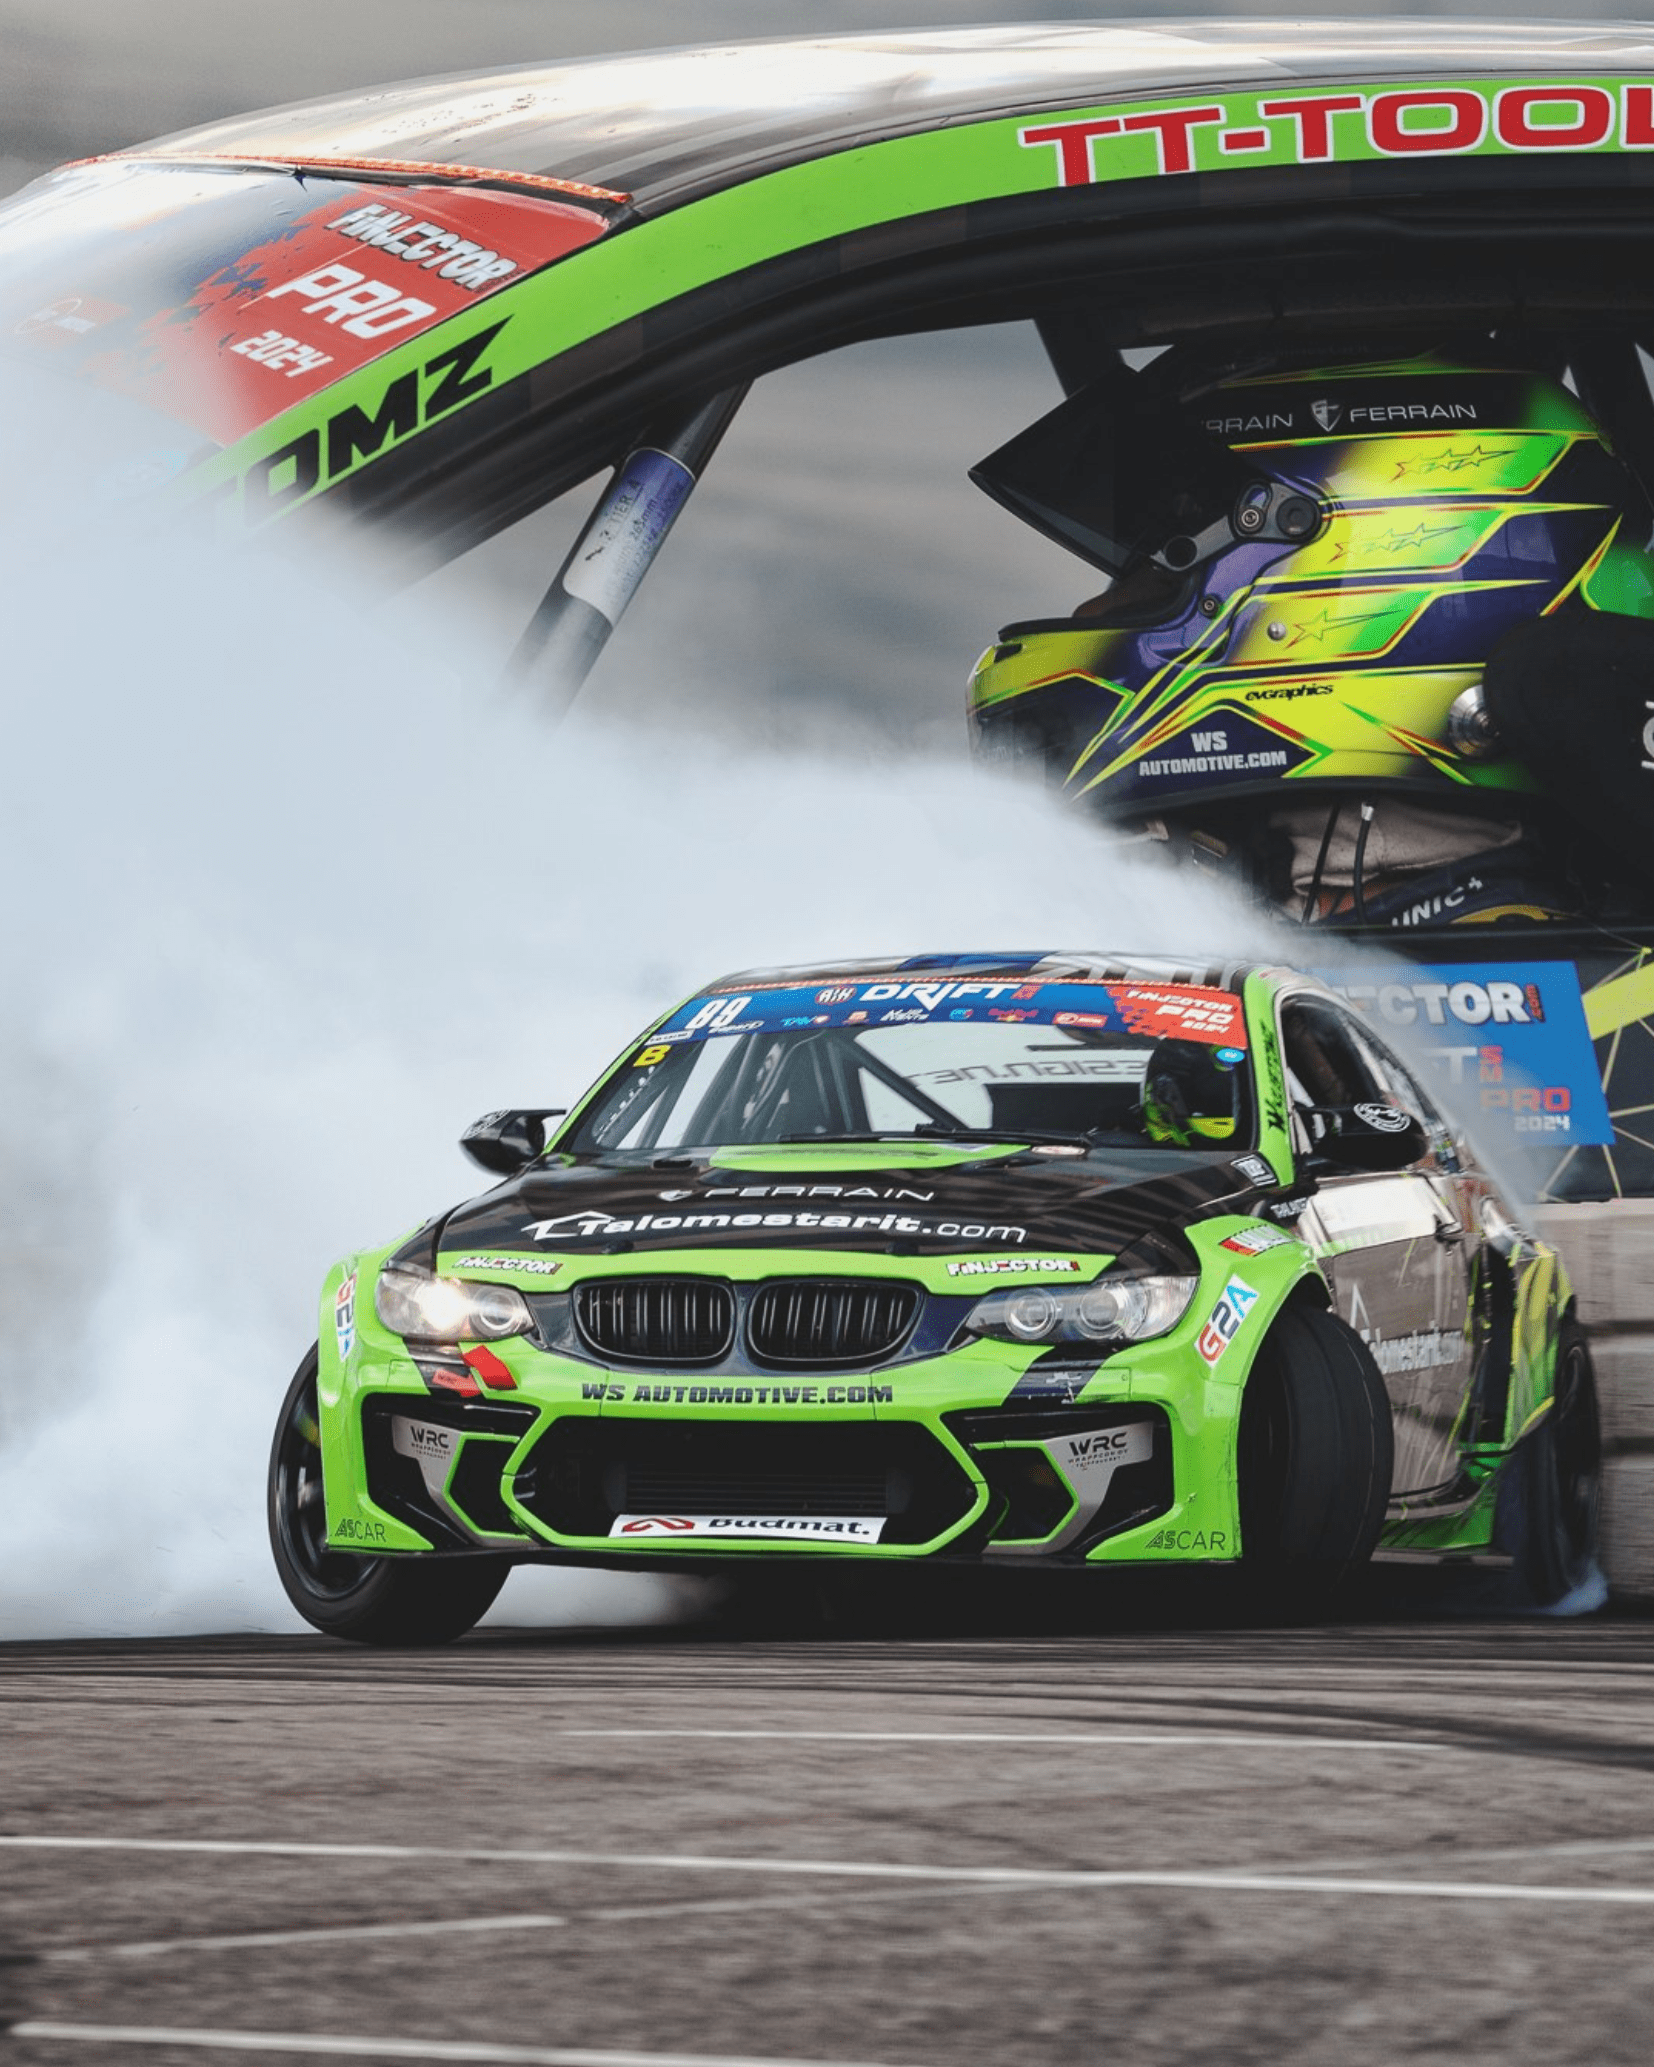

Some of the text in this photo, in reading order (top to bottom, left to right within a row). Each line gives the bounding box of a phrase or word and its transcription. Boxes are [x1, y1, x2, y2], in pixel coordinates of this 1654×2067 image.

[266, 264, 437, 339] PRO
[230, 329, 334, 377] 2024
[1206, 404, 1477, 433] RRAIN FERRAIN
[1191, 731, 1227, 752] WS
[1139, 750, 1287, 776] AUTOMOTIVE.COM
[859, 983, 1022, 1011] DRIFT
[1480, 1087, 1571, 1113] PRO
[1514, 1115, 1571, 1132] 2024
[705, 1187, 934, 1201] FERRAIN
[577, 1212, 1027, 1243] Talomestarit.com
[1199, 1286, 1257, 1362] G2A
[582, 1383, 893, 1404] WS AUTOMOTIVE.COM
[410, 1425, 449, 1449] WRC
[1069, 1432, 1127, 1456] WRC
[335, 1518, 386, 1542] ASCAR
[1145, 1529, 1225, 1551] ASCAR
